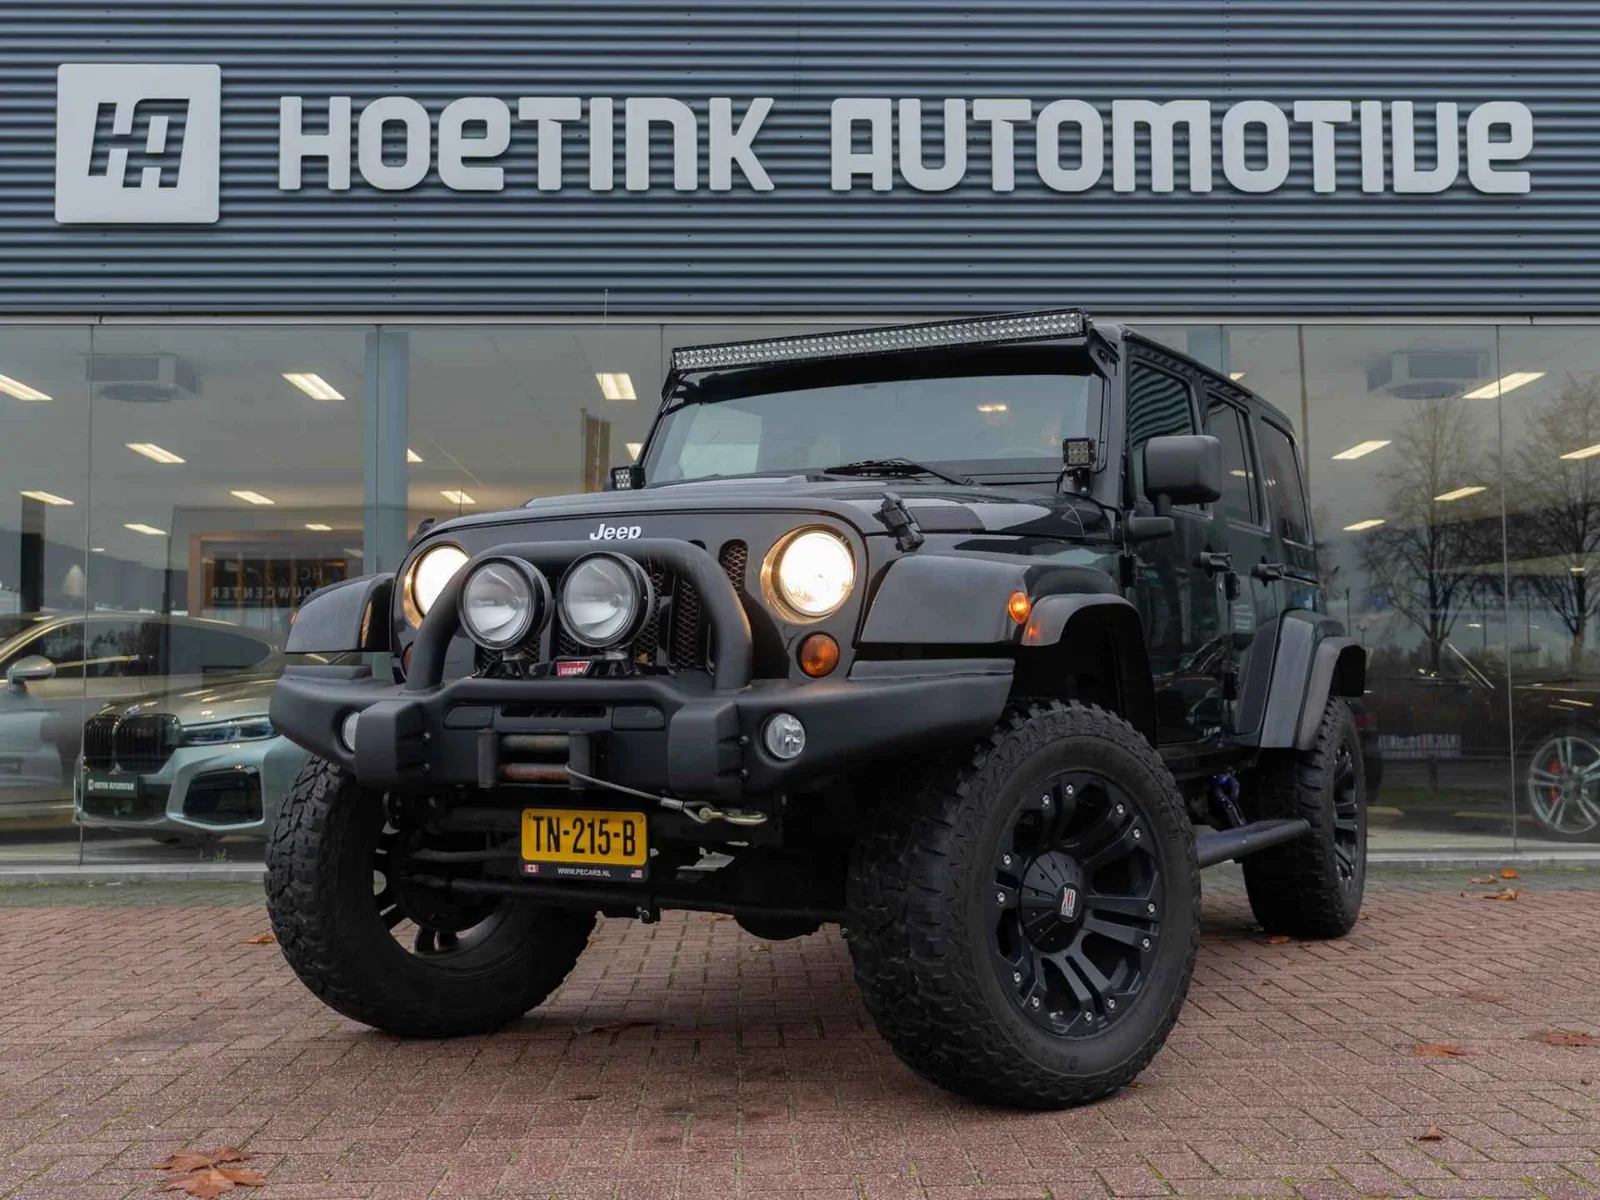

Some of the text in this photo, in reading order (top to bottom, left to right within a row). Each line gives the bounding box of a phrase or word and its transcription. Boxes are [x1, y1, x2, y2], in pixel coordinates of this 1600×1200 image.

[279, 96, 1533, 193] HOETINK AUTOMOTIVE
[590, 523, 642, 540] Jeep
[533, 815, 636, 856] TN-215-B
